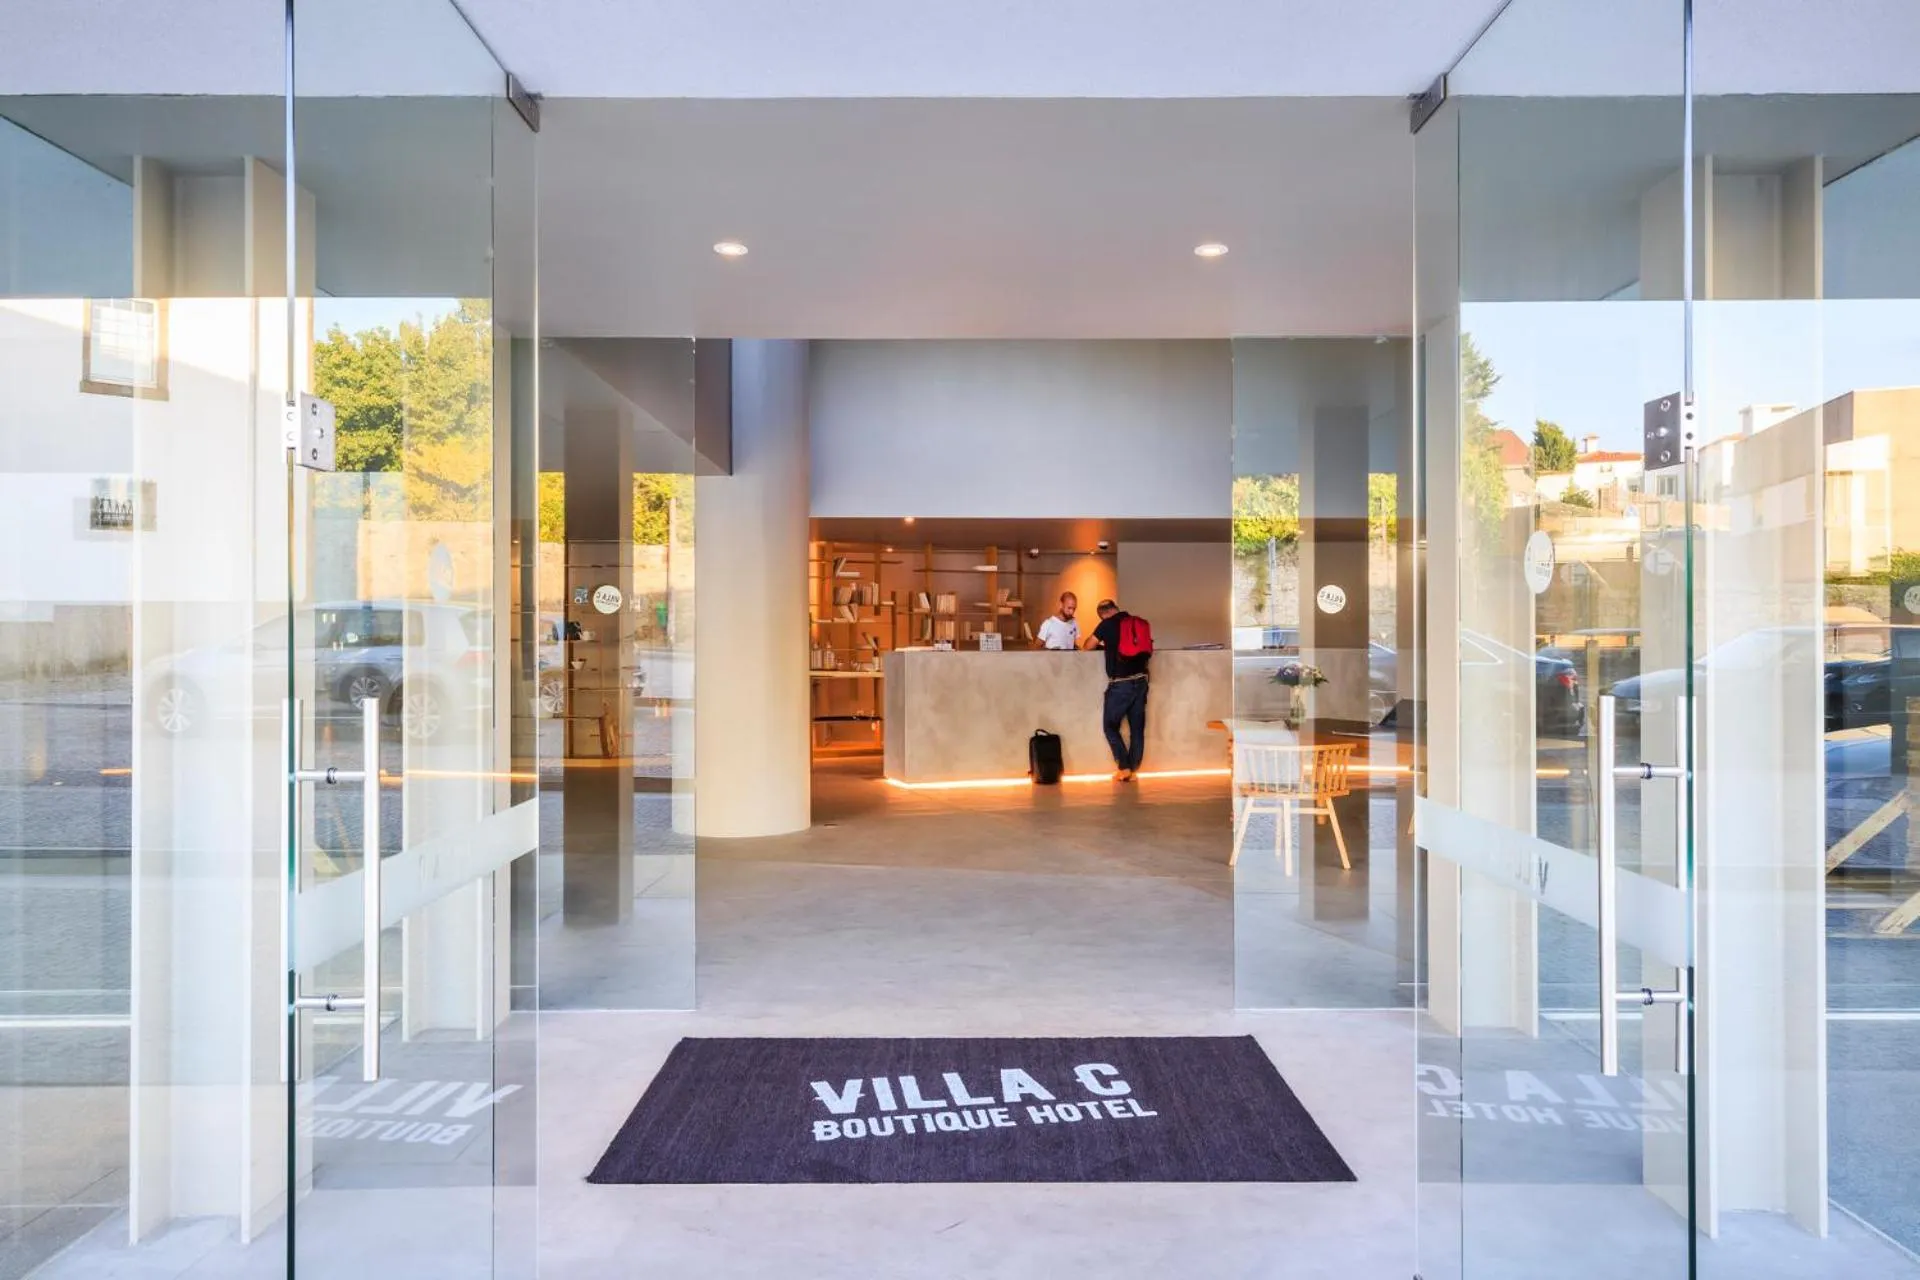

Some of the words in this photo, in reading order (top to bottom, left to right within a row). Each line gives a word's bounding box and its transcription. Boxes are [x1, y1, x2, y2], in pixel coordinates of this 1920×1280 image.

[811, 1068, 1056, 1114] VILLA
[1075, 1063, 1132, 1096] C
[812, 1107, 1017, 1141] BOUTIQUE
[1025, 1098, 1158, 1125] HOTEL
